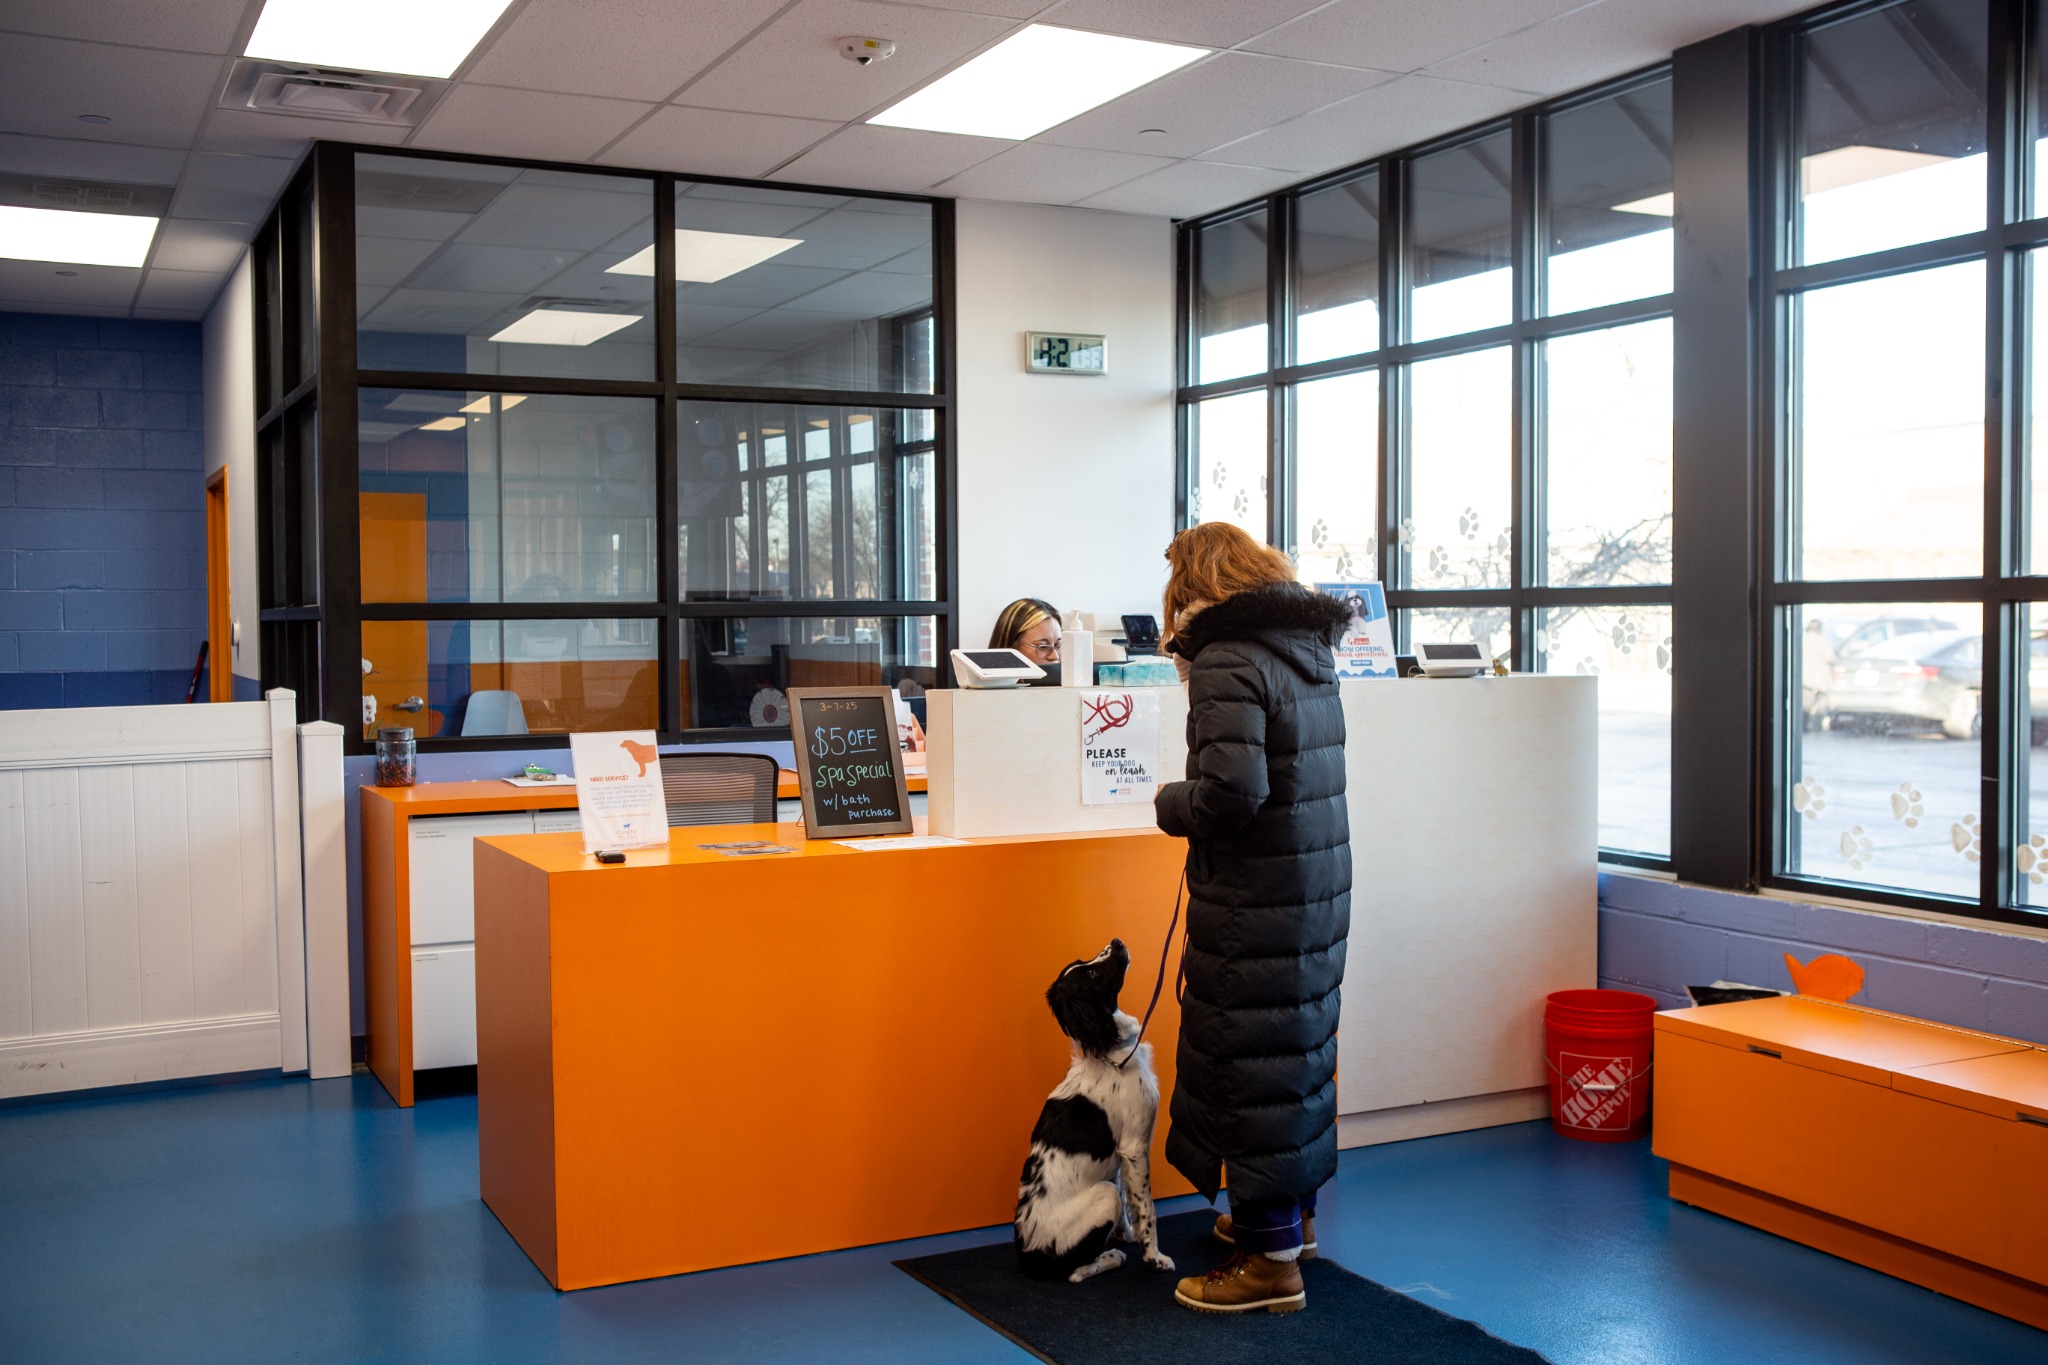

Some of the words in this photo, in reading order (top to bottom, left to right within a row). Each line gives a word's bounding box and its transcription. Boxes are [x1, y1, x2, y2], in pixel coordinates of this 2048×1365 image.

[820, 702, 857, 711] 3-7-25
[812, 726, 846, 758] $5
[848, 729, 877, 746] OFF
[1087, 748, 1126, 759] PLEASE
[1092, 760, 1105, 768] KEEP
[1105, 768, 1117, 776] on
[1120, 763, 1146, 775] leash
[816, 765, 844, 788] Spa
[842, 794, 870, 806] bath
[848, 808, 894, 820] purchase
[1567, 1063, 1596, 1091] THE
[1561, 1058, 1632, 1126] HOME
[1585, 1084, 1631, 1129] DEPOT
